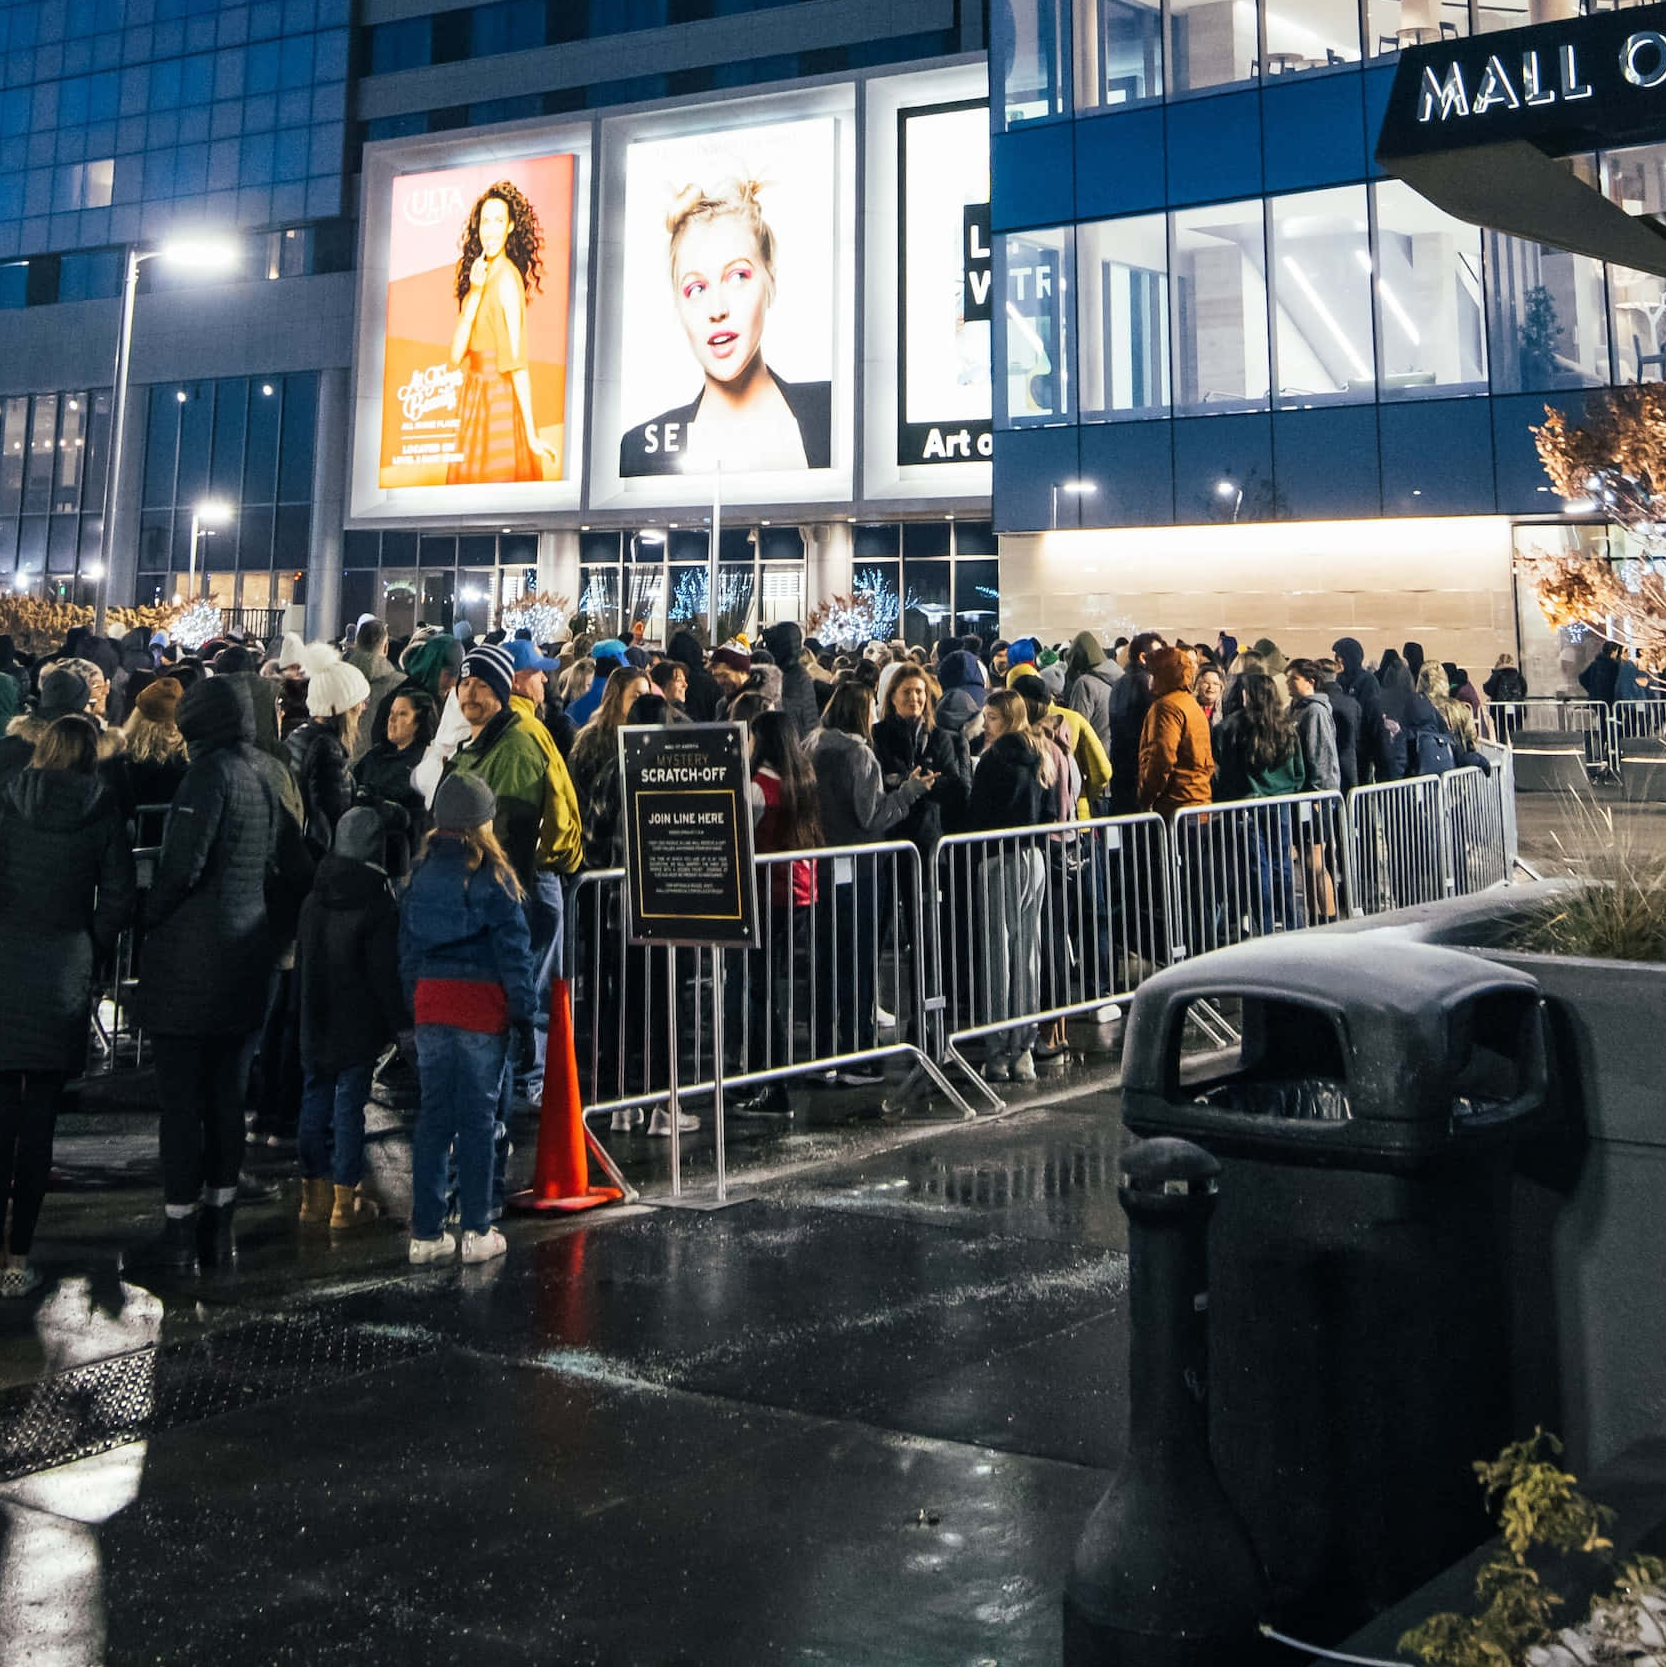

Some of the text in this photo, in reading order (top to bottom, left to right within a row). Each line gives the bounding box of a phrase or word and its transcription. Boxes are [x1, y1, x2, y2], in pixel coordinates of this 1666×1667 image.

[1417, 43, 1593, 122] MALL
[922, 428, 971, 459] Art
[656, 753, 709, 766] MYSTERY
[641, 767, 727, 783] SCRATCH-OFF
[648, 812, 724, 825] JOIN LINE HERE
